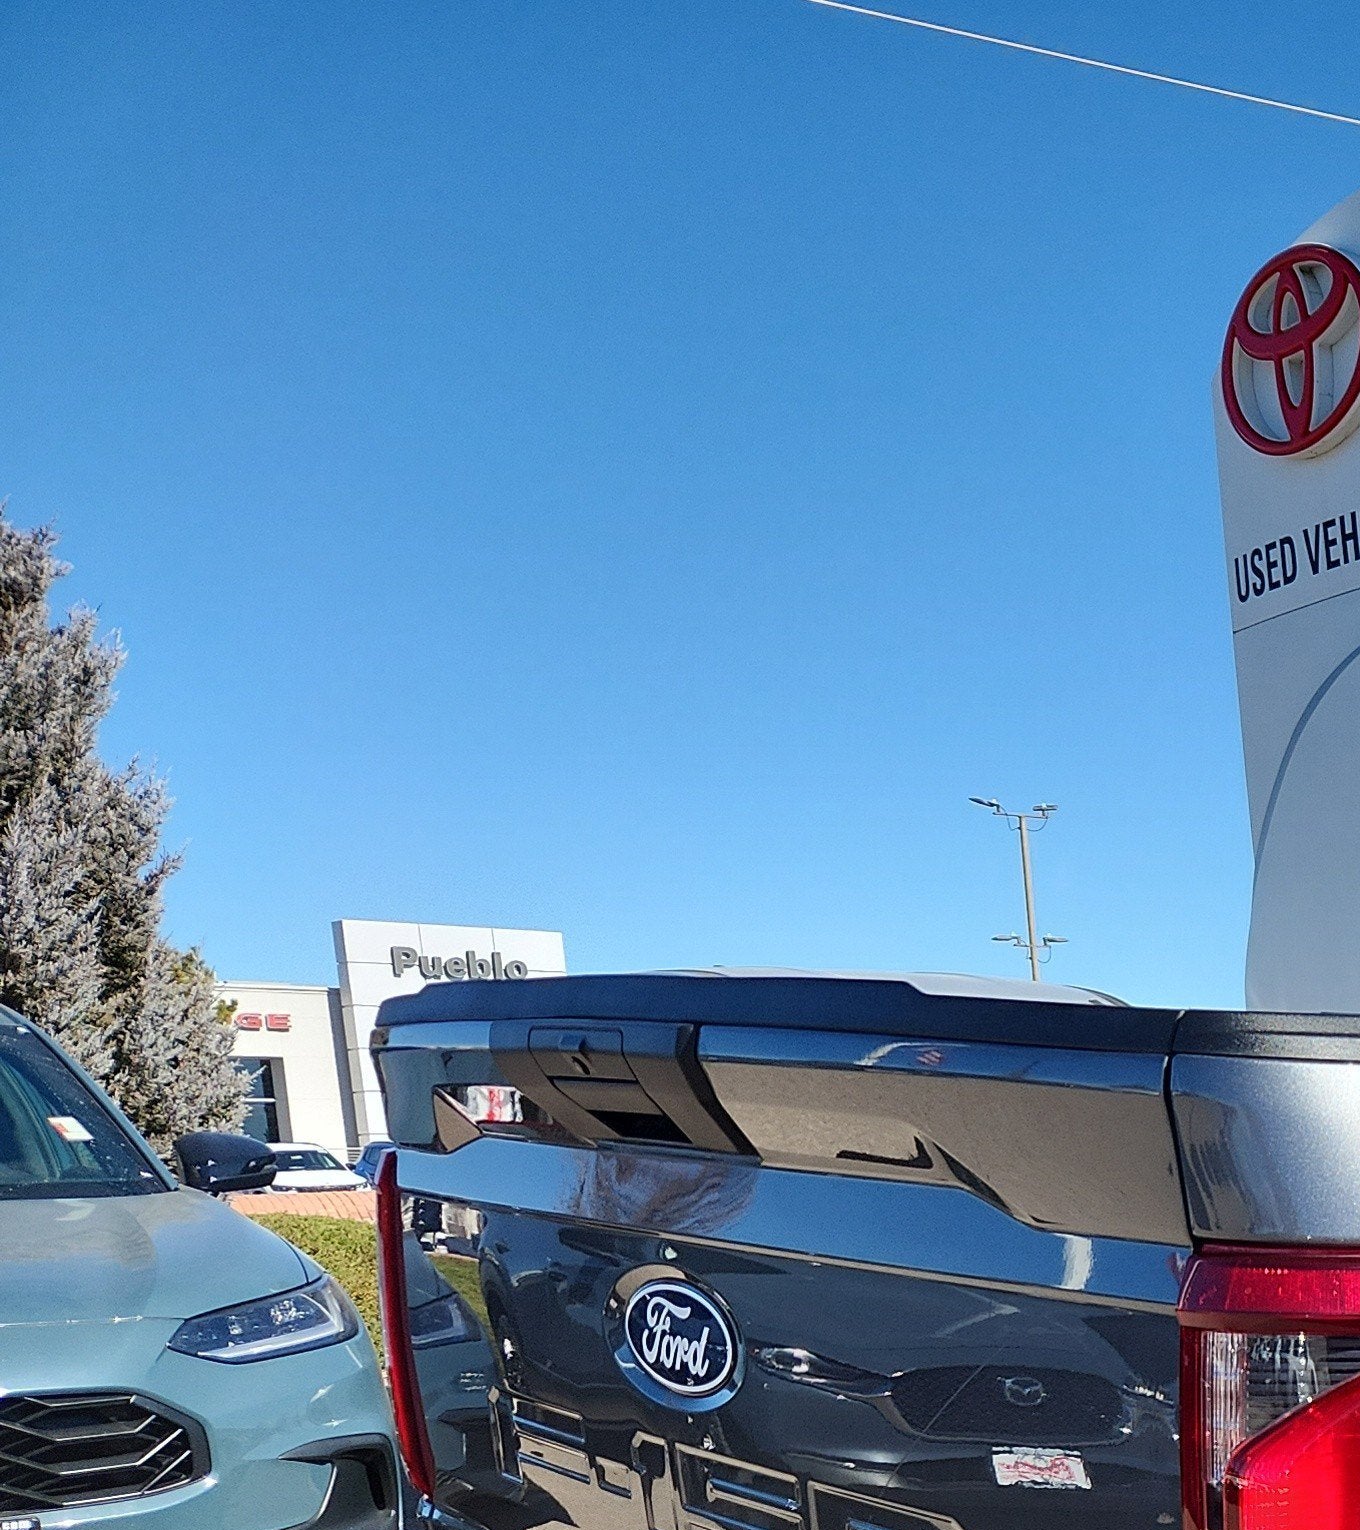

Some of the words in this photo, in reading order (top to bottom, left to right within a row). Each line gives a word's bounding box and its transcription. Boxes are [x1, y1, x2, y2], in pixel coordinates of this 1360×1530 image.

[1234, 535, 1298, 603] USED
[389, 945, 529, 980] Pueblo
[235, 1013, 292, 1032] GE
[641, 1296, 710, 1378] Ford
